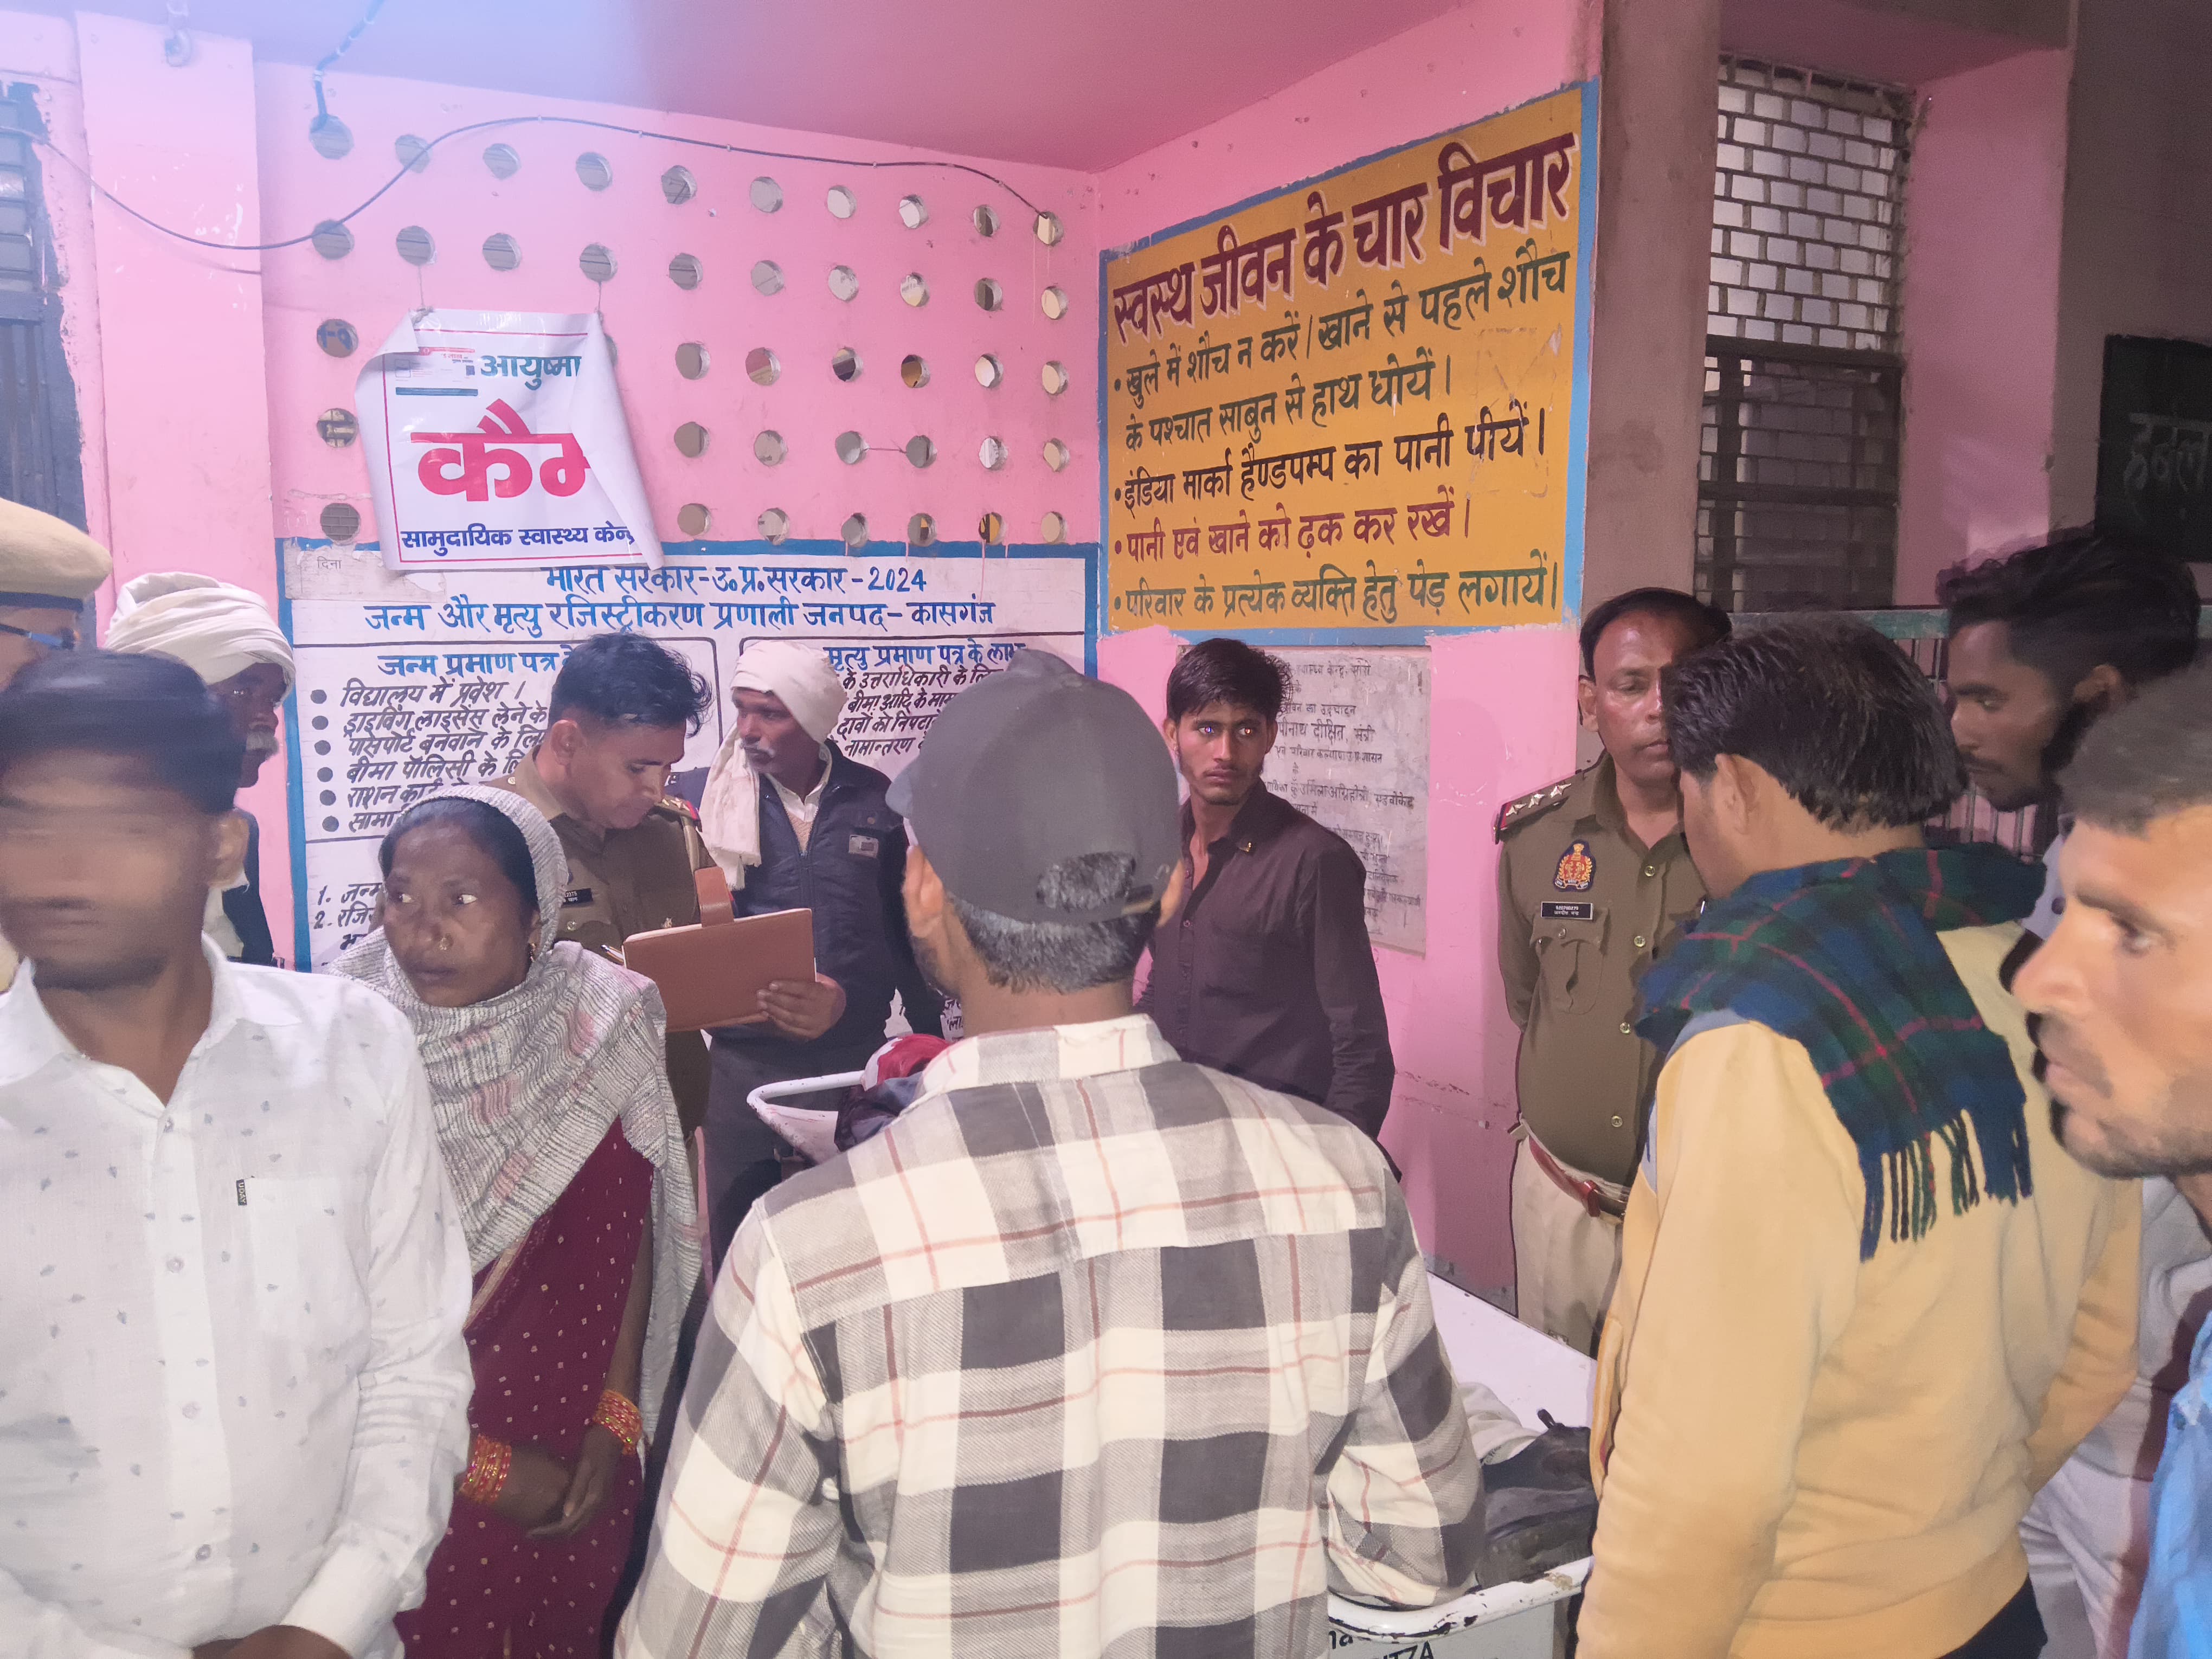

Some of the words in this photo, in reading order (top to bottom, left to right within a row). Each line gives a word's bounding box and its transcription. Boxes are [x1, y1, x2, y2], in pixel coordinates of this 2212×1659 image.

[1113, 262, 1195, 344] स्वस्थ
[1199, 224, 1298, 316] जीवन
[1303, 190, 1345, 287] के
[1352, 182, 1429, 271] चार
[1436, 132, 1579, 253] विचार
[1127, 349, 1161, 409] खुले
[1167, 342, 1181, 388] में
[1187, 330, 1231, 383] शौच
[1238, 336, 1252, 369] न
[1317, 288, 1374, 351] खाने
[1383, 279, 1410, 333] से
[1420, 257, 1492, 330] पहले
[1497, 238, 1571, 308] शौच
[480, 355, 582, 390] आयुष्मा
[1126, 413, 1143, 451] के
[1149, 407, 1213, 447] पश्चात
[1219, 392, 1278, 444] साबुन
[1285, 372, 1306, 425] से
[1311, 374, 1362, 428] हाथ
[1124, 468, 1175, 518] इंडिया
[1183, 447, 1231, 501] मार्का
[1240, 444, 1335, 501] हैण्डपम्प
[1345, 441, 1382, 477] का
[1394, 413, 1454, 468] पानी
[401, 523, 513, 556] सामुदायिक
[518, 528, 588, 546] स्वास्थ्य
[1127, 518, 1164, 563] पानी
[1173, 516, 1200, 560] एवं
[1208, 510, 1251, 555] खाने
[1258, 503, 1289, 552] को
[1353, 507, 1398, 544] कर
[1126, 577, 1186, 619] परिवार
[1194, 574, 1214, 615] के
[1223, 570, 1286, 619] प्रत्येक
[1291, 564, 1356, 615] व्यक्ति
[1363, 560, 1400, 624] हेतु
[1407, 559, 1450, 616] पेड़
[363, 605, 432, 631] जन्म
[438, 594, 491, 632] और
[493, 603, 543, 638] मृत्यु
[709, 596, 799, 629] प्रणाली
[905, 593, 996, 626] कासगंज
[377, 655, 438, 676] जन्म
[442, 654, 517, 678] प्रमाण
[518, 653, 560, 672] पत्र
[822, 646, 871, 672] मृत्यु
[872, 646, 936, 667] प्रमाण
[937, 645, 966, 665] पत्र
[967, 637, 985, 665] के
[340, 678, 427, 707] विद्यालय
[429, 677, 455, 704] में
[953, 665, 971, 686] के
[847, 690, 882, 713] बीमा
[880, 687, 914, 713] आदि
[914, 687, 928, 709] के
[344, 704, 415, 737] ड्राइविंग
[415, 704, 489, 734] लाइसेंस
[492, 702, 535, 728] लेने
[530, 700, 548, 724] के
[837, 711, 873, 741] दावों
[872, 711, 894, 733] को
[348, 728, 416, 758] पासपोर्ट
[419, 728, 488, 755] बनवाने
[491, 726, 512, 750] के
[844, 737, 917, 757] नामान्तरण
[346, 756, 398, 783] बीमा
[402, 750, 477, 780] पॉलिसी
[478, 750, 498, 777] के
